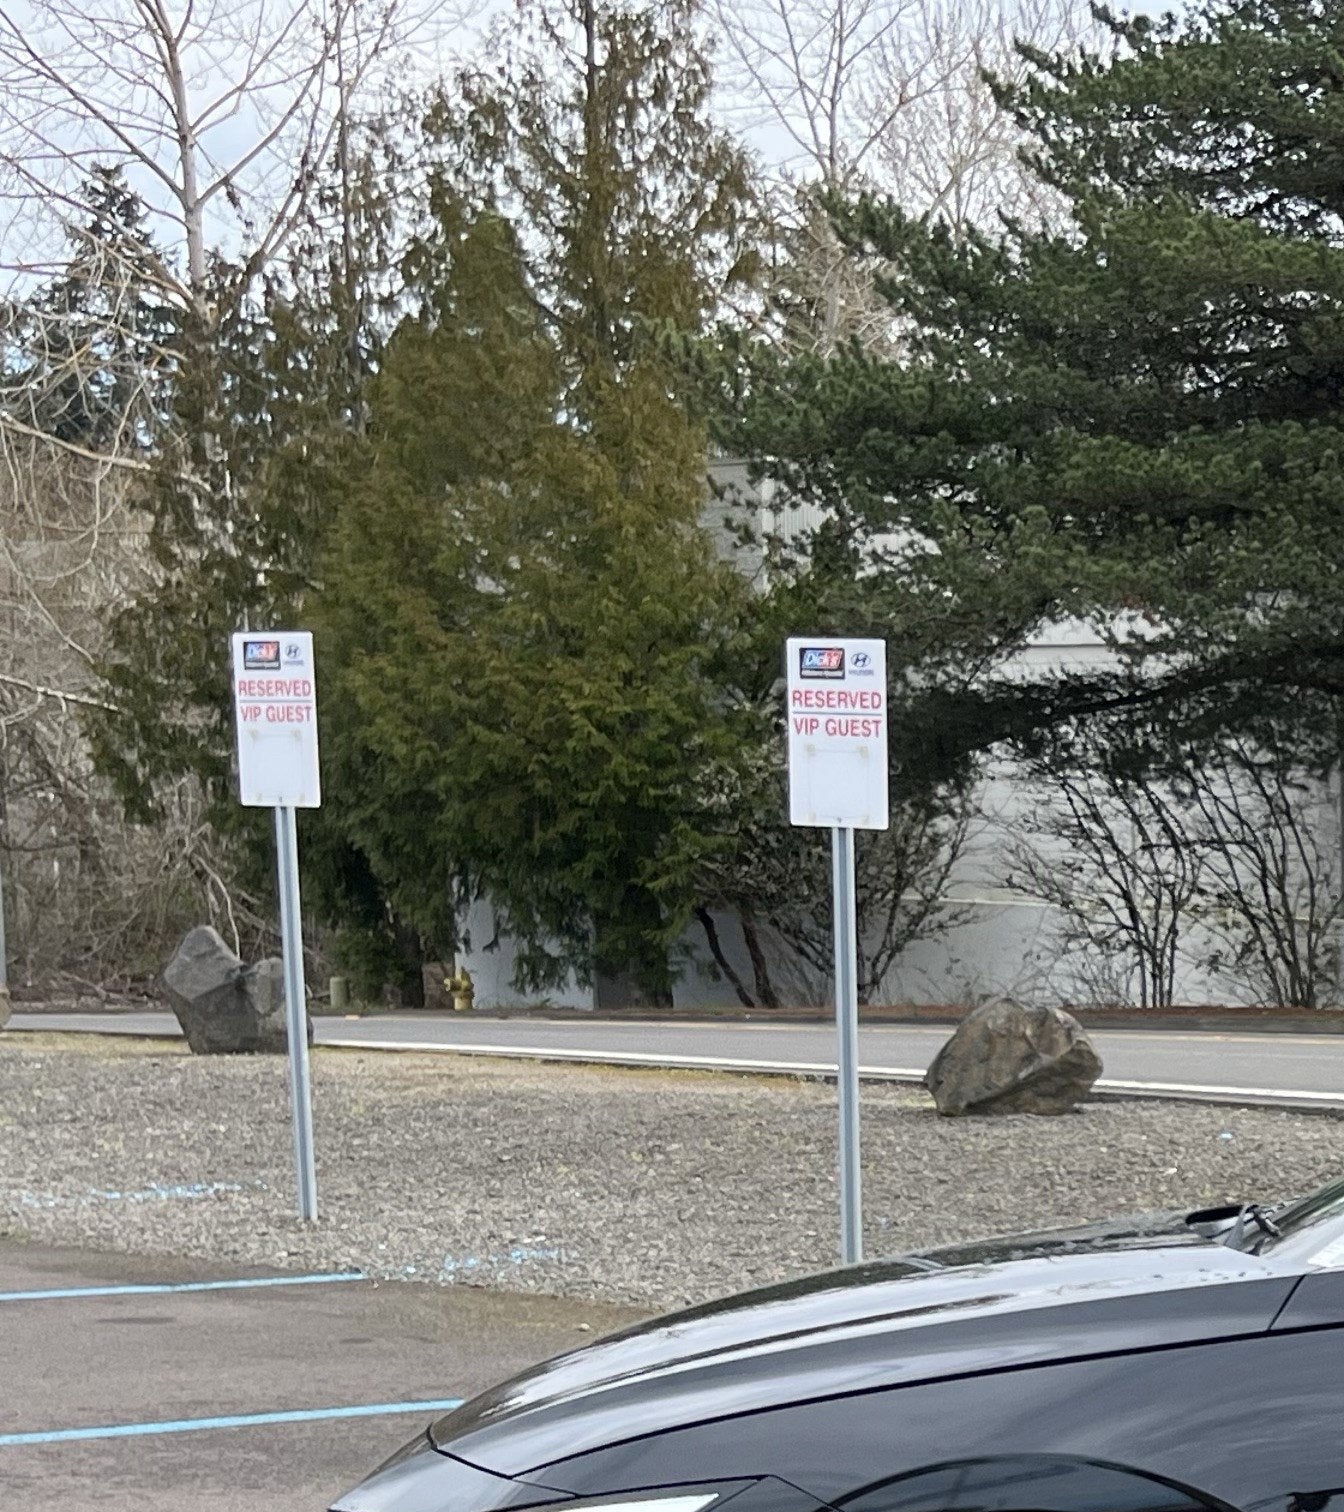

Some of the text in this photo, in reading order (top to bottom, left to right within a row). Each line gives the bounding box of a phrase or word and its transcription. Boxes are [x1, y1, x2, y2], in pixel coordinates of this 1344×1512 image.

[238, 680, 312, 698] RESERVED
[792, 689, 882, 710] RESERVED
[240, 705, 313, 723] VIP GUEST
[793, 717, 883, 738] VIP GUEST
